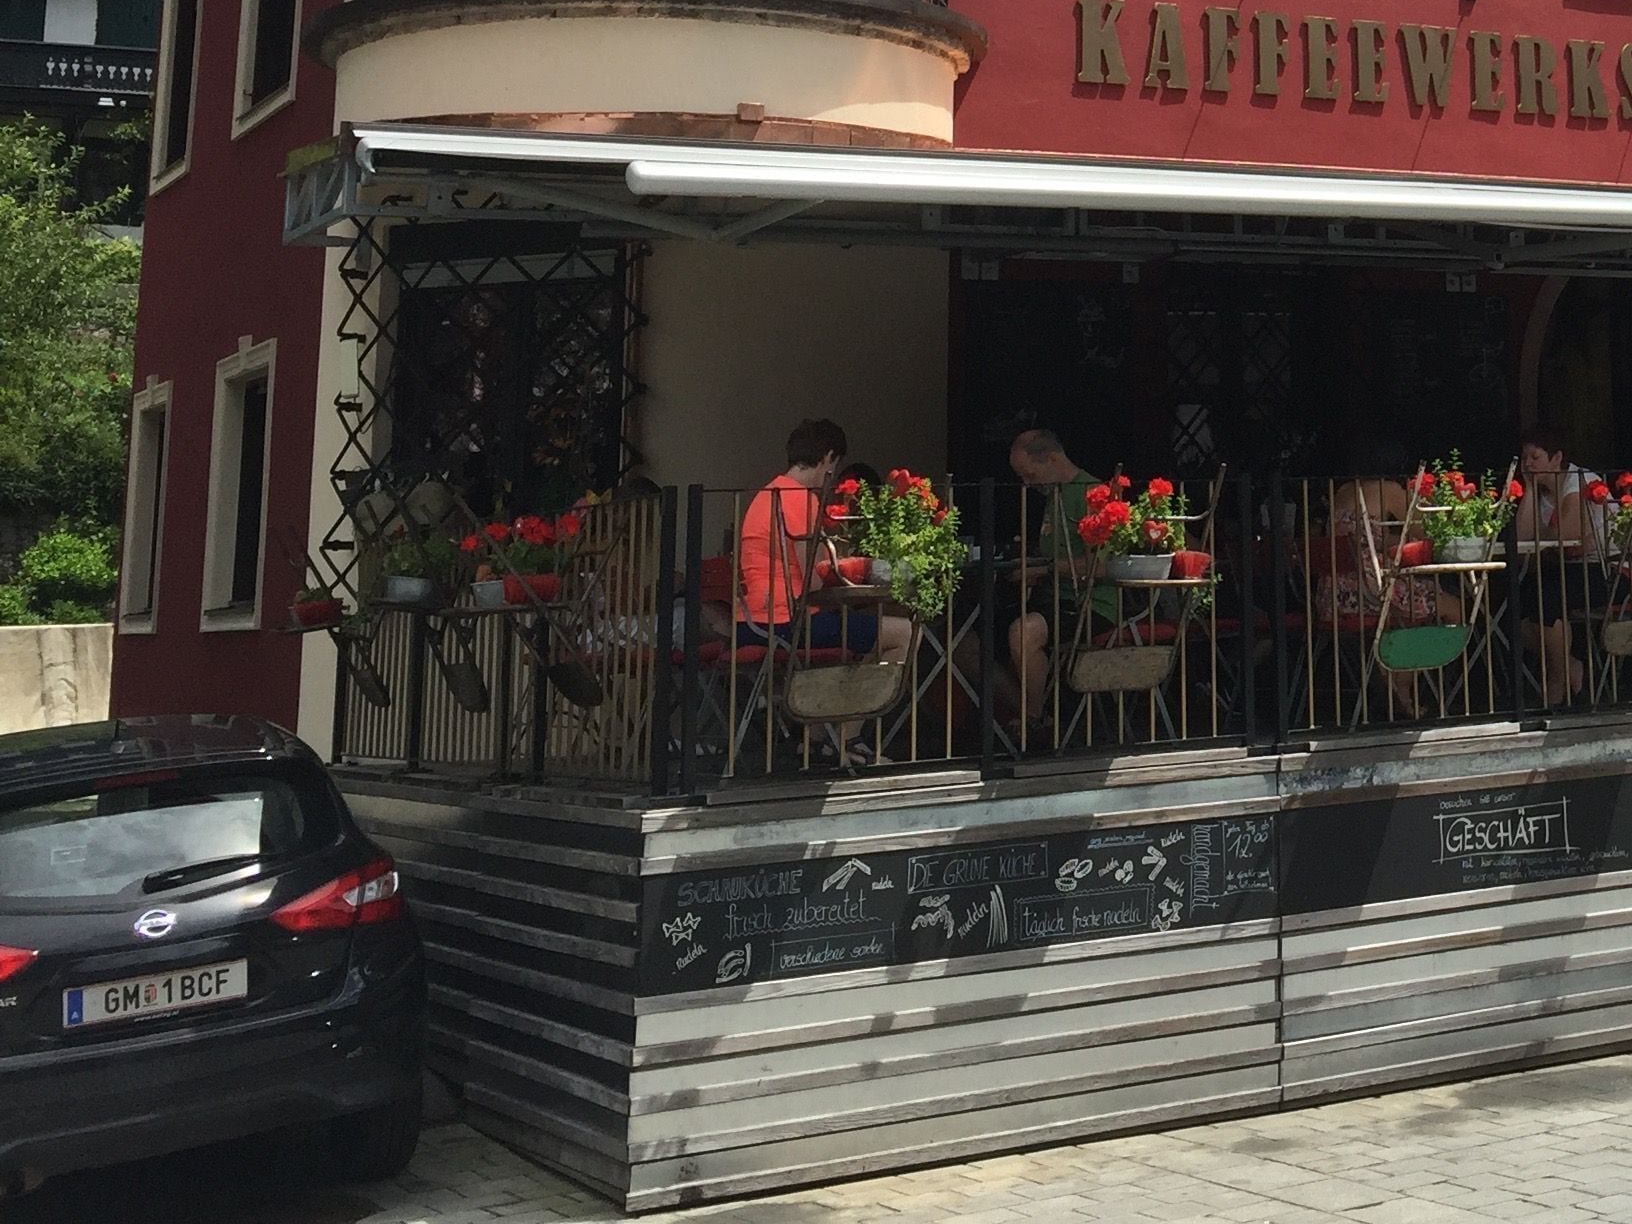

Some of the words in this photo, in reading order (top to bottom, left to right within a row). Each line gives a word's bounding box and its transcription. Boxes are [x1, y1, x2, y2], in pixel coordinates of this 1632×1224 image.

[1445, 809, 1562, 853] GESCHÄFT
[943, 852, 992, 886] GRÜNE
[999, 848, 1037, 878] KÜCHE
[726, 904, 772, 939] frisch
[785, 889, 867, 929] zubereitet
[1022, 905, 1066, 941] täglich
[104, 982, 140, 1015] GM
